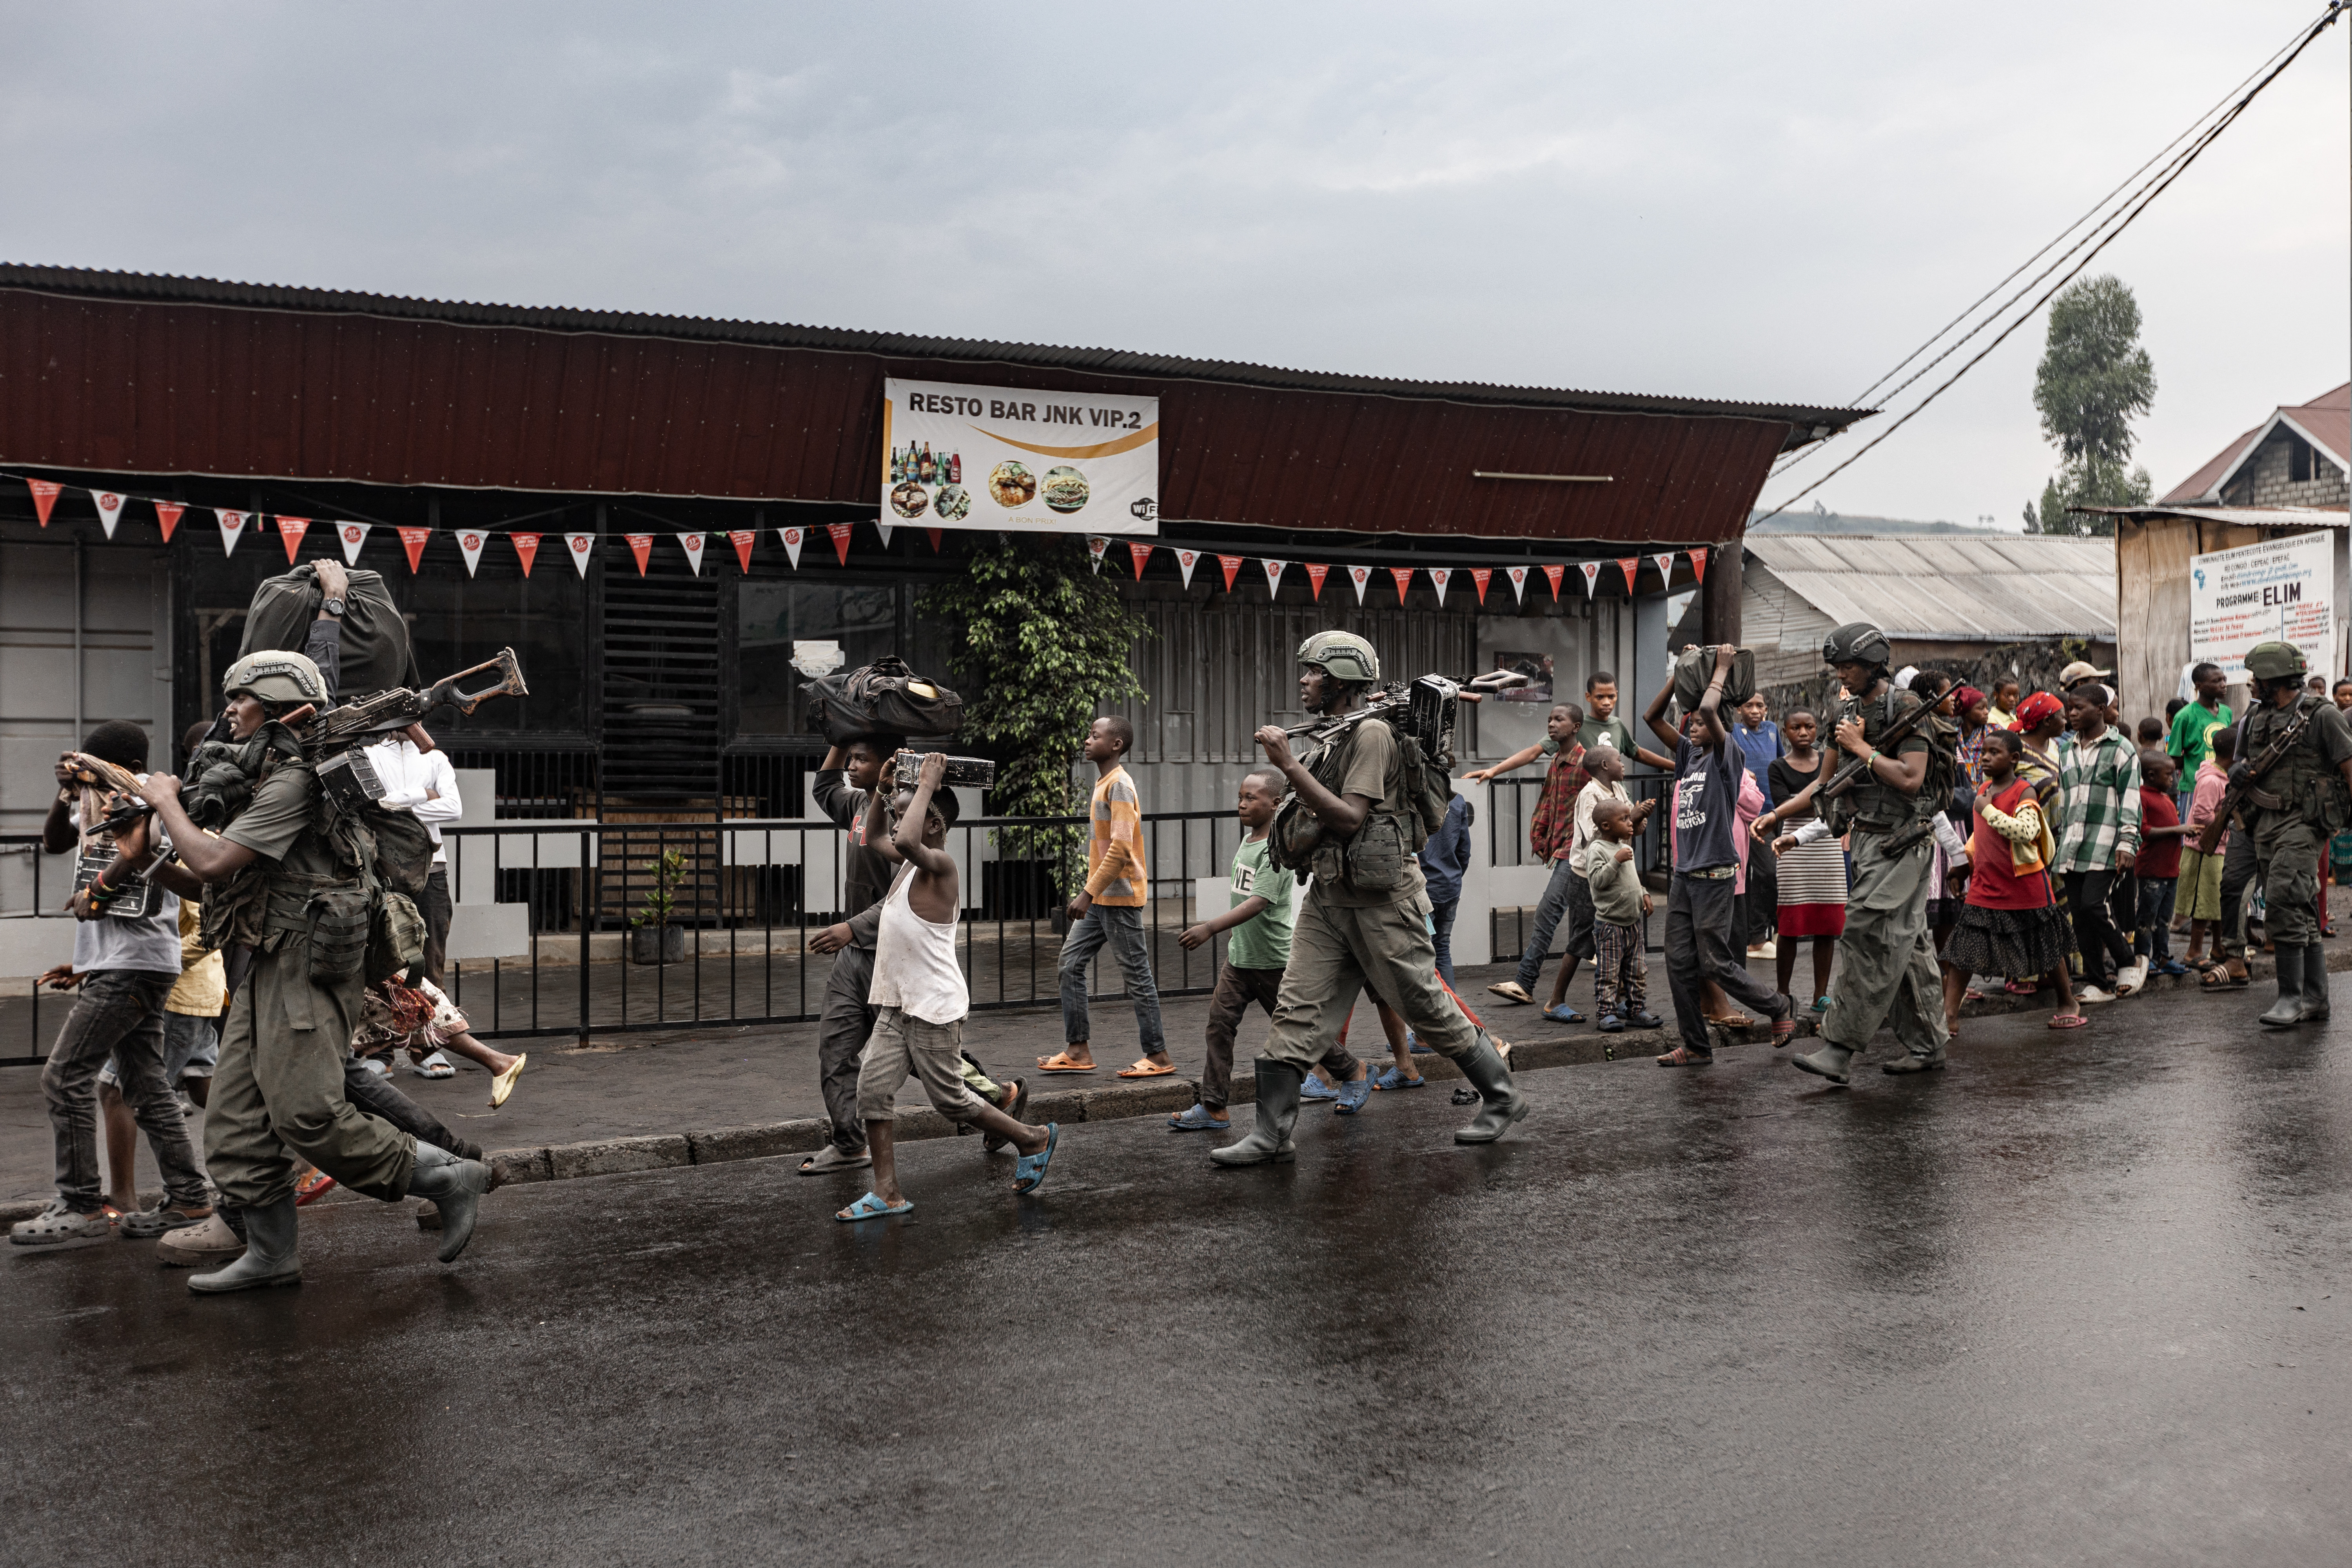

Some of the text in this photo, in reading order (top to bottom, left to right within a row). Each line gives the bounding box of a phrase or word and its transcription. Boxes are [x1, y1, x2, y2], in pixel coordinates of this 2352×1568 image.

[910, 392, 1141, 429] RESTO BAR JNK VIP.2
[2198, 553, 2225, 566] COMMUNAUTE
[2225, 550, 2235, 561] ELIM
[2263, 540, 2296, 553] EVANGELIQUE
[2297, 538, 2303, 547] EN
[2305, 533, 2325, 545] AFRIQUE
[2225, 564, 2230, 573] RD
[2231, 561, 2247, 572] CONGO
[2263, 580, 2301, 608] ELIM
[2298, 641, 2319, 651] NVENUE
